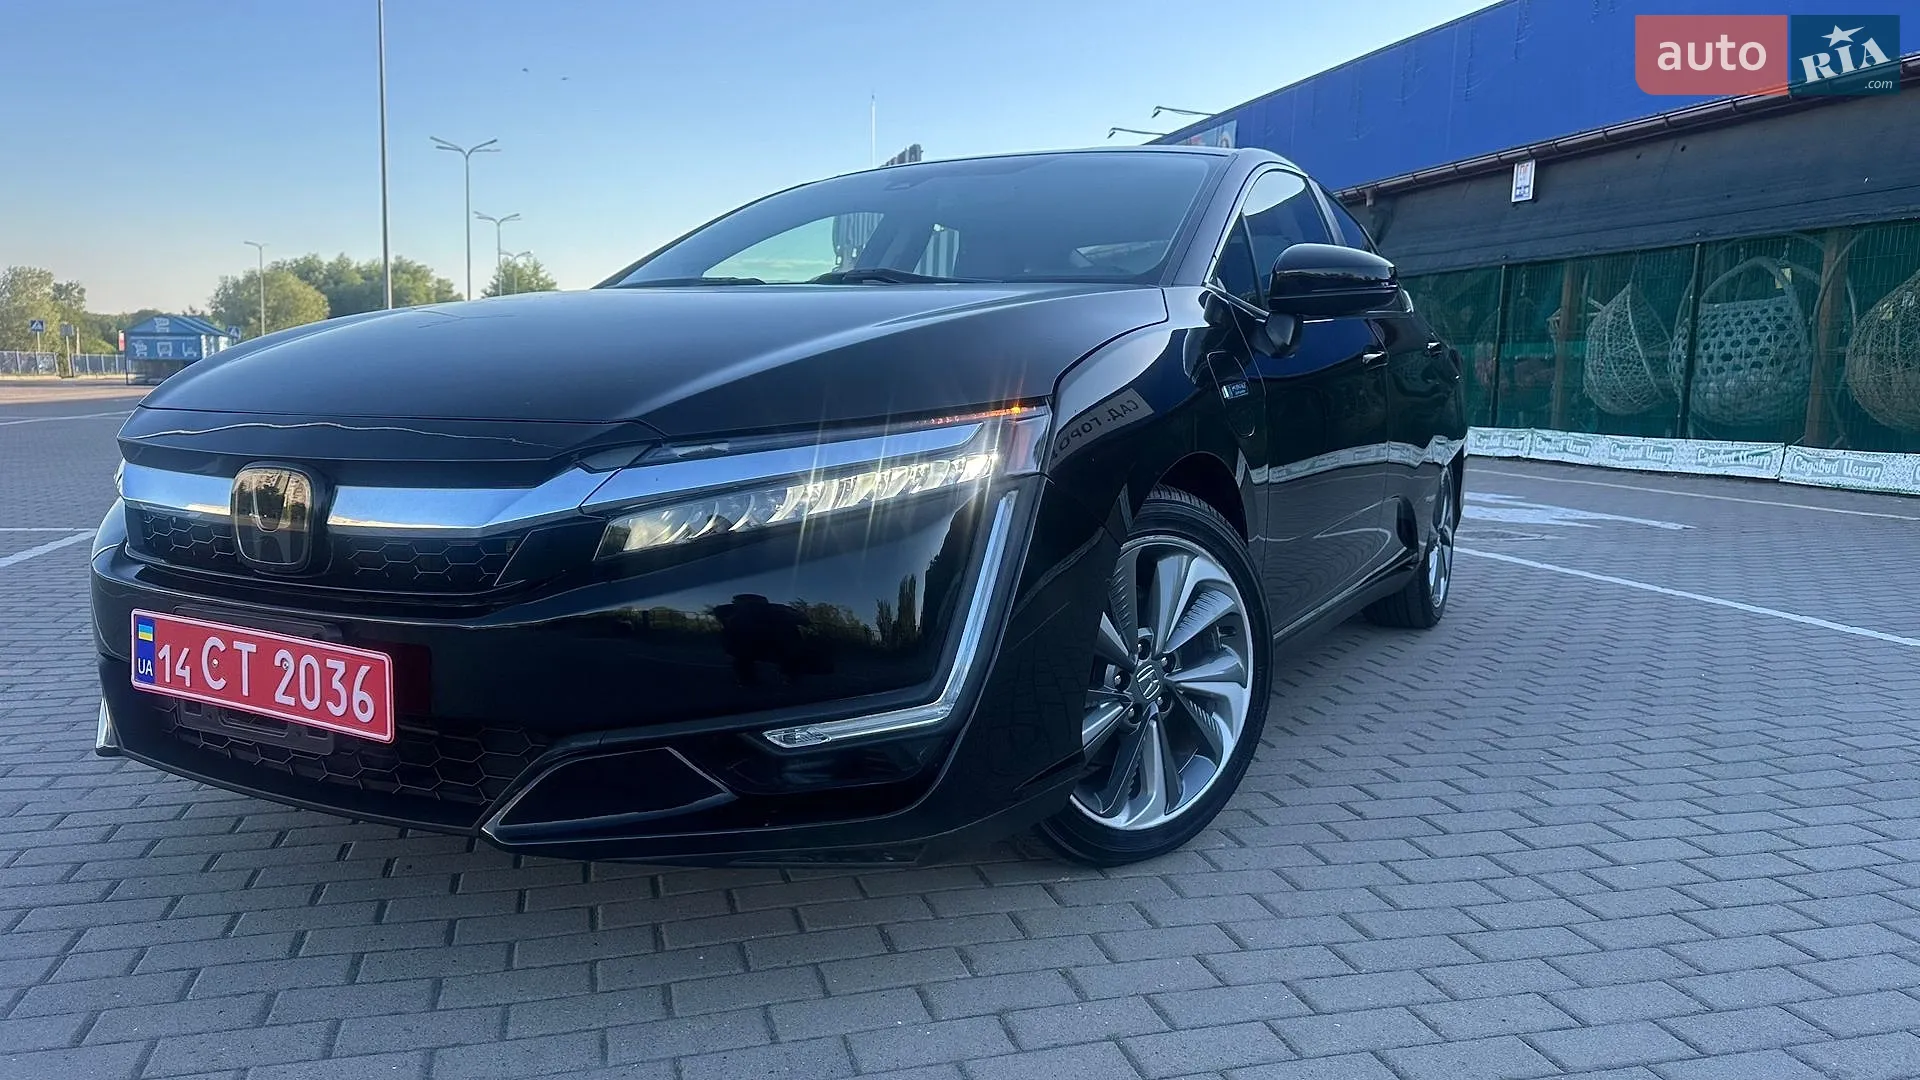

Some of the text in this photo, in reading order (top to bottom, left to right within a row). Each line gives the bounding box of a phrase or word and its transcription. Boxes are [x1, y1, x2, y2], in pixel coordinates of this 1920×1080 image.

[1646, 445, 1672, 464] Центр
[1843, 459, 1881, 482] Центр
[138, 657, 153, 677] UA
[158, 644, 191, 687] 14
[273, 649, 375, 723] 2036
